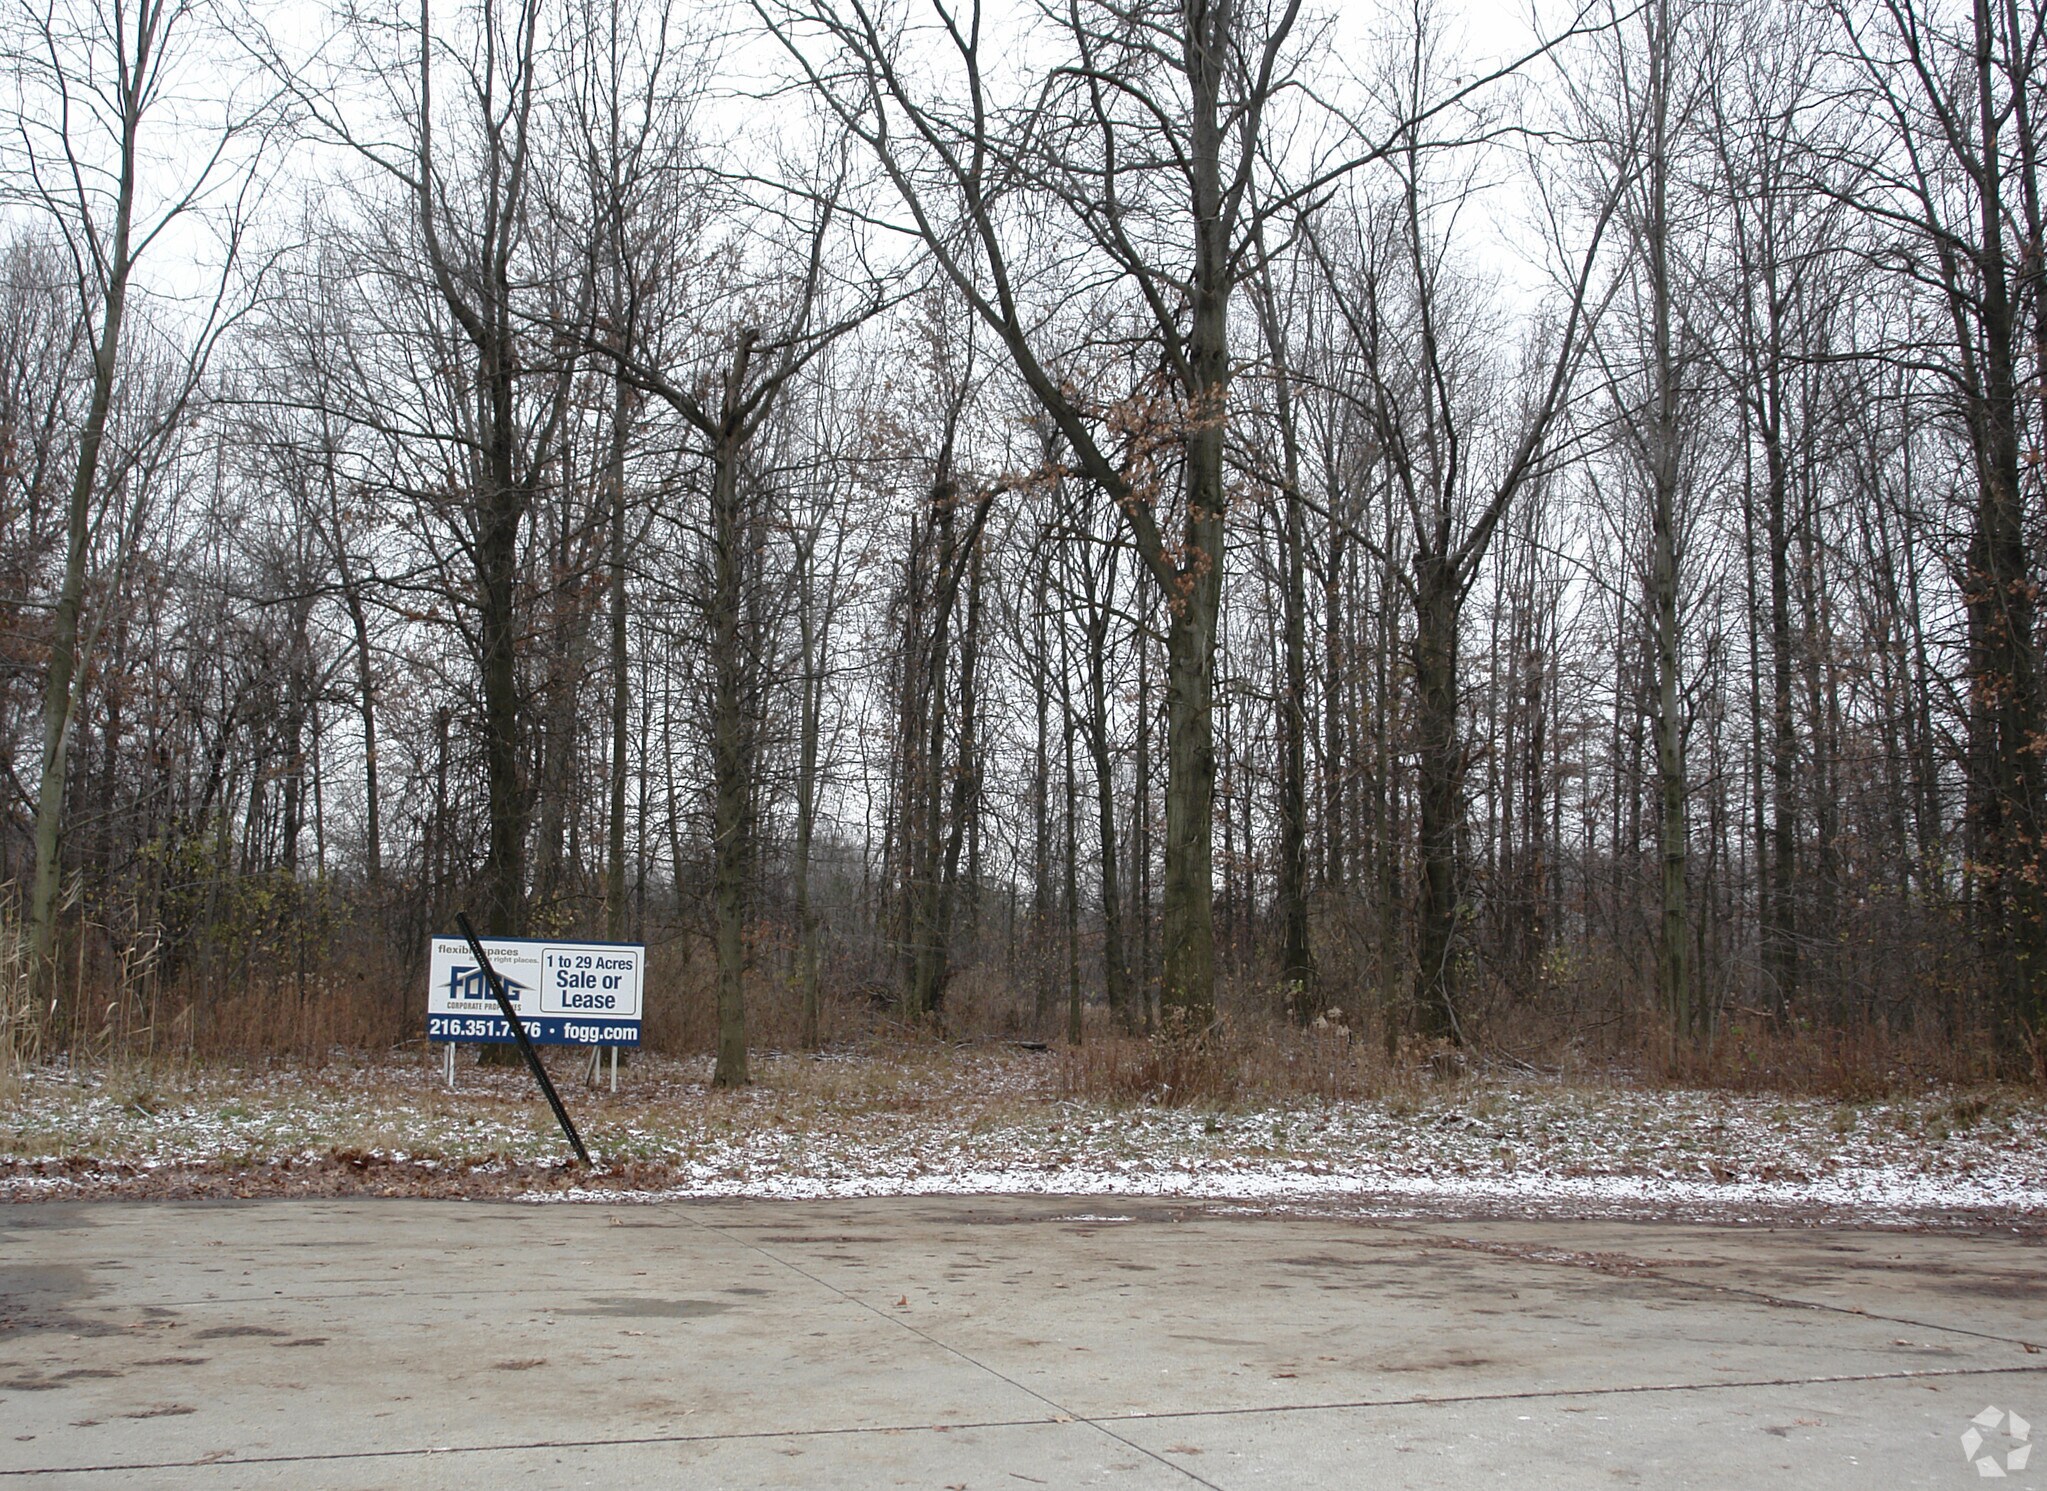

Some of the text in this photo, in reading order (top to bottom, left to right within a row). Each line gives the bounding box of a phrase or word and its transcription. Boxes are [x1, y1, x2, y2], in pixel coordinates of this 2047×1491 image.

[547, 954, 633, 970] 1 to 29 Acres
[556, 970, 622, 990] Sale or
[447, 1001, 482, 1010] CORPORATE
[562, 990, 616, 1009] Lease
[429, 1018, 638, 1043] 216.351.776 fogg.com
